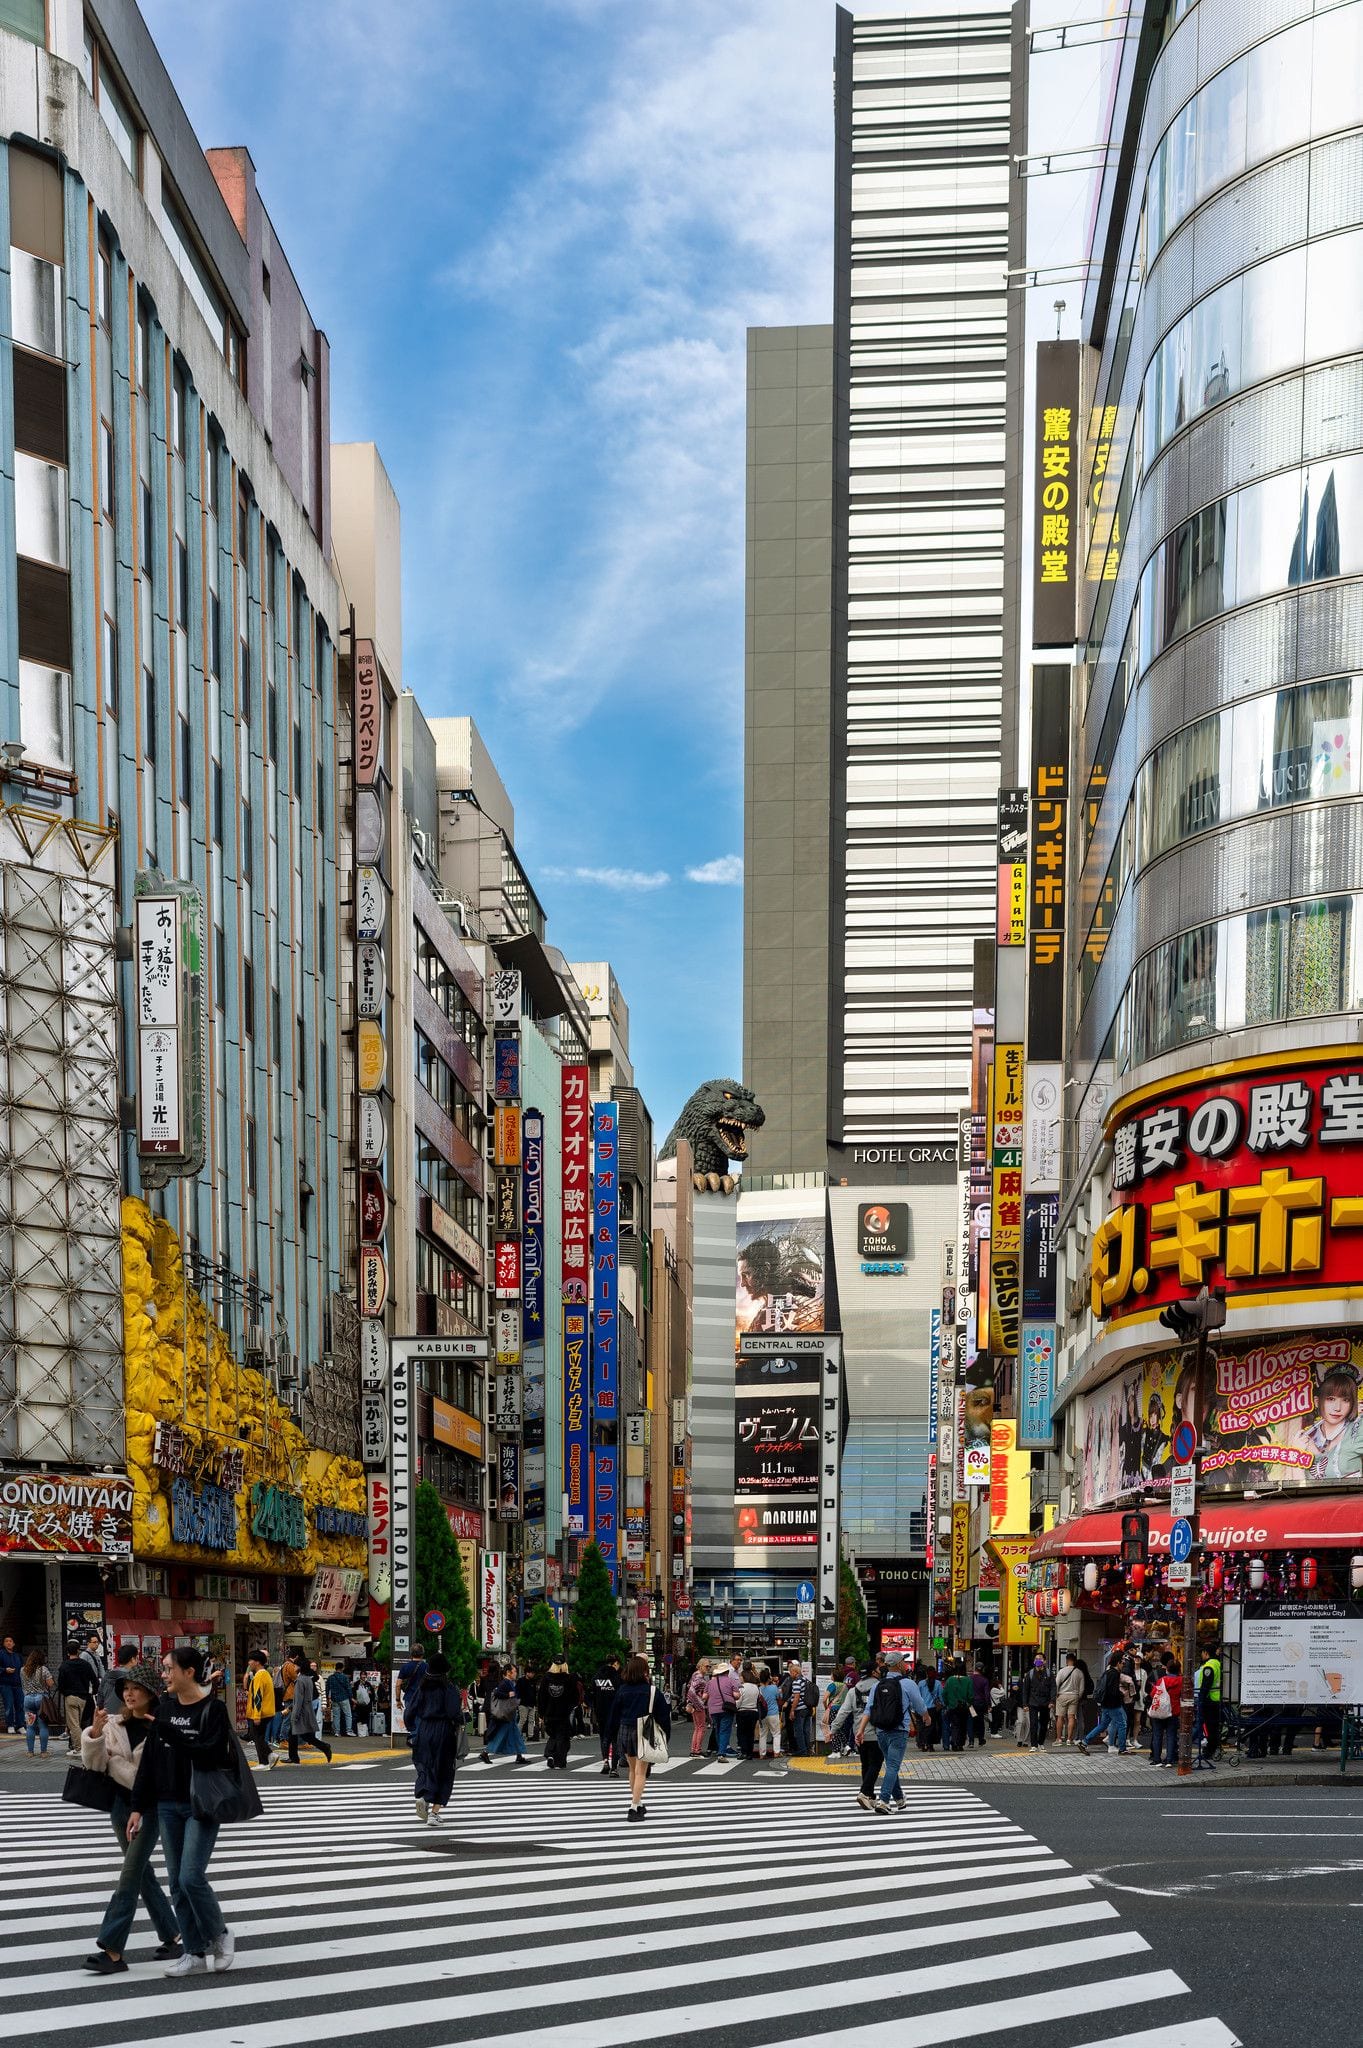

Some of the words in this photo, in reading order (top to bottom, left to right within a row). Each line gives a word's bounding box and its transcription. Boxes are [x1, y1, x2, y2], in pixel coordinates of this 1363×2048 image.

[1041, 407, 1071, 583] 驚安の殿堂
[358, 655, 372, 665] 新宿
[1036, 767, 1064, 965] ドン・キホーテ
[1012, 869, 1024, 929] Garam
[362, 930, 373, 938] 7F
[360, 1003, 376, 1013] 6F
[1006, 1050, 1020, 1105] 生ビール
[152, 1105, 168, 1124] 光
[365, 1139, 374, 1150] 光
[1114, 1076, 1363, 1191] 驚安の殿堂
[155, 1142, 168, 1152] 4F
[854, 1149, 906, 1163] HOTEL
[565, 1075, 586, 1269] カラオケ歌広場
[861, 1262, 904, 1273] IMAX
[567, 1316, 584, 1334] 薬
[502, 1353, 515, 1362] 3F
[744, 1341, 794, 1350] CENTRAL
[796, 1341, 825, 1349] ROAD
[1217, 1341, 1348, 1393] Halloween
[366, 1380, 377, 1389] 1F
[567, 1340, 583, 1432] マツモトキヨシ
[1029, 1366, 1039, 1408] STAGE
[1039, 1366, 1049, 1401] IDOL
[1229, 1367, 1309, 1409] connects
[1220, 1412, 1250, 1430] the
[1252, 1384, 1311, 1424] world
[365, 1408, 380, 1446] かっぱ
[739, 1417, 820, 1443] ヴェノム
[367, 1449, 379, 1457] B1
[394, 1382, 408, 1512] GODZILLA
[968, 1450, 989, 1464] Rio
[503, 1447, 515, 1481] 海の家
[761, 1463, 783, 1475] 11.1
[784, 1467, 796, 1475] FRI
[0, 1483, 133, 1512] ONOMIYAKI
[825, 1398, 838, 1575] ゴジラロード
[372, 1481, 389, 1555] トラノコ
[763, 1510, 817, 1525] MARUHAN
[1148, 1530, 1172, 1546] Do
[1174, 1529, 1184, 1556] P
[395, 1527, 409, 1589] ROAD
[879, 1571, 909, 1580] TOHO
[1306, 1610, 1331, 1619] Shinjuku
